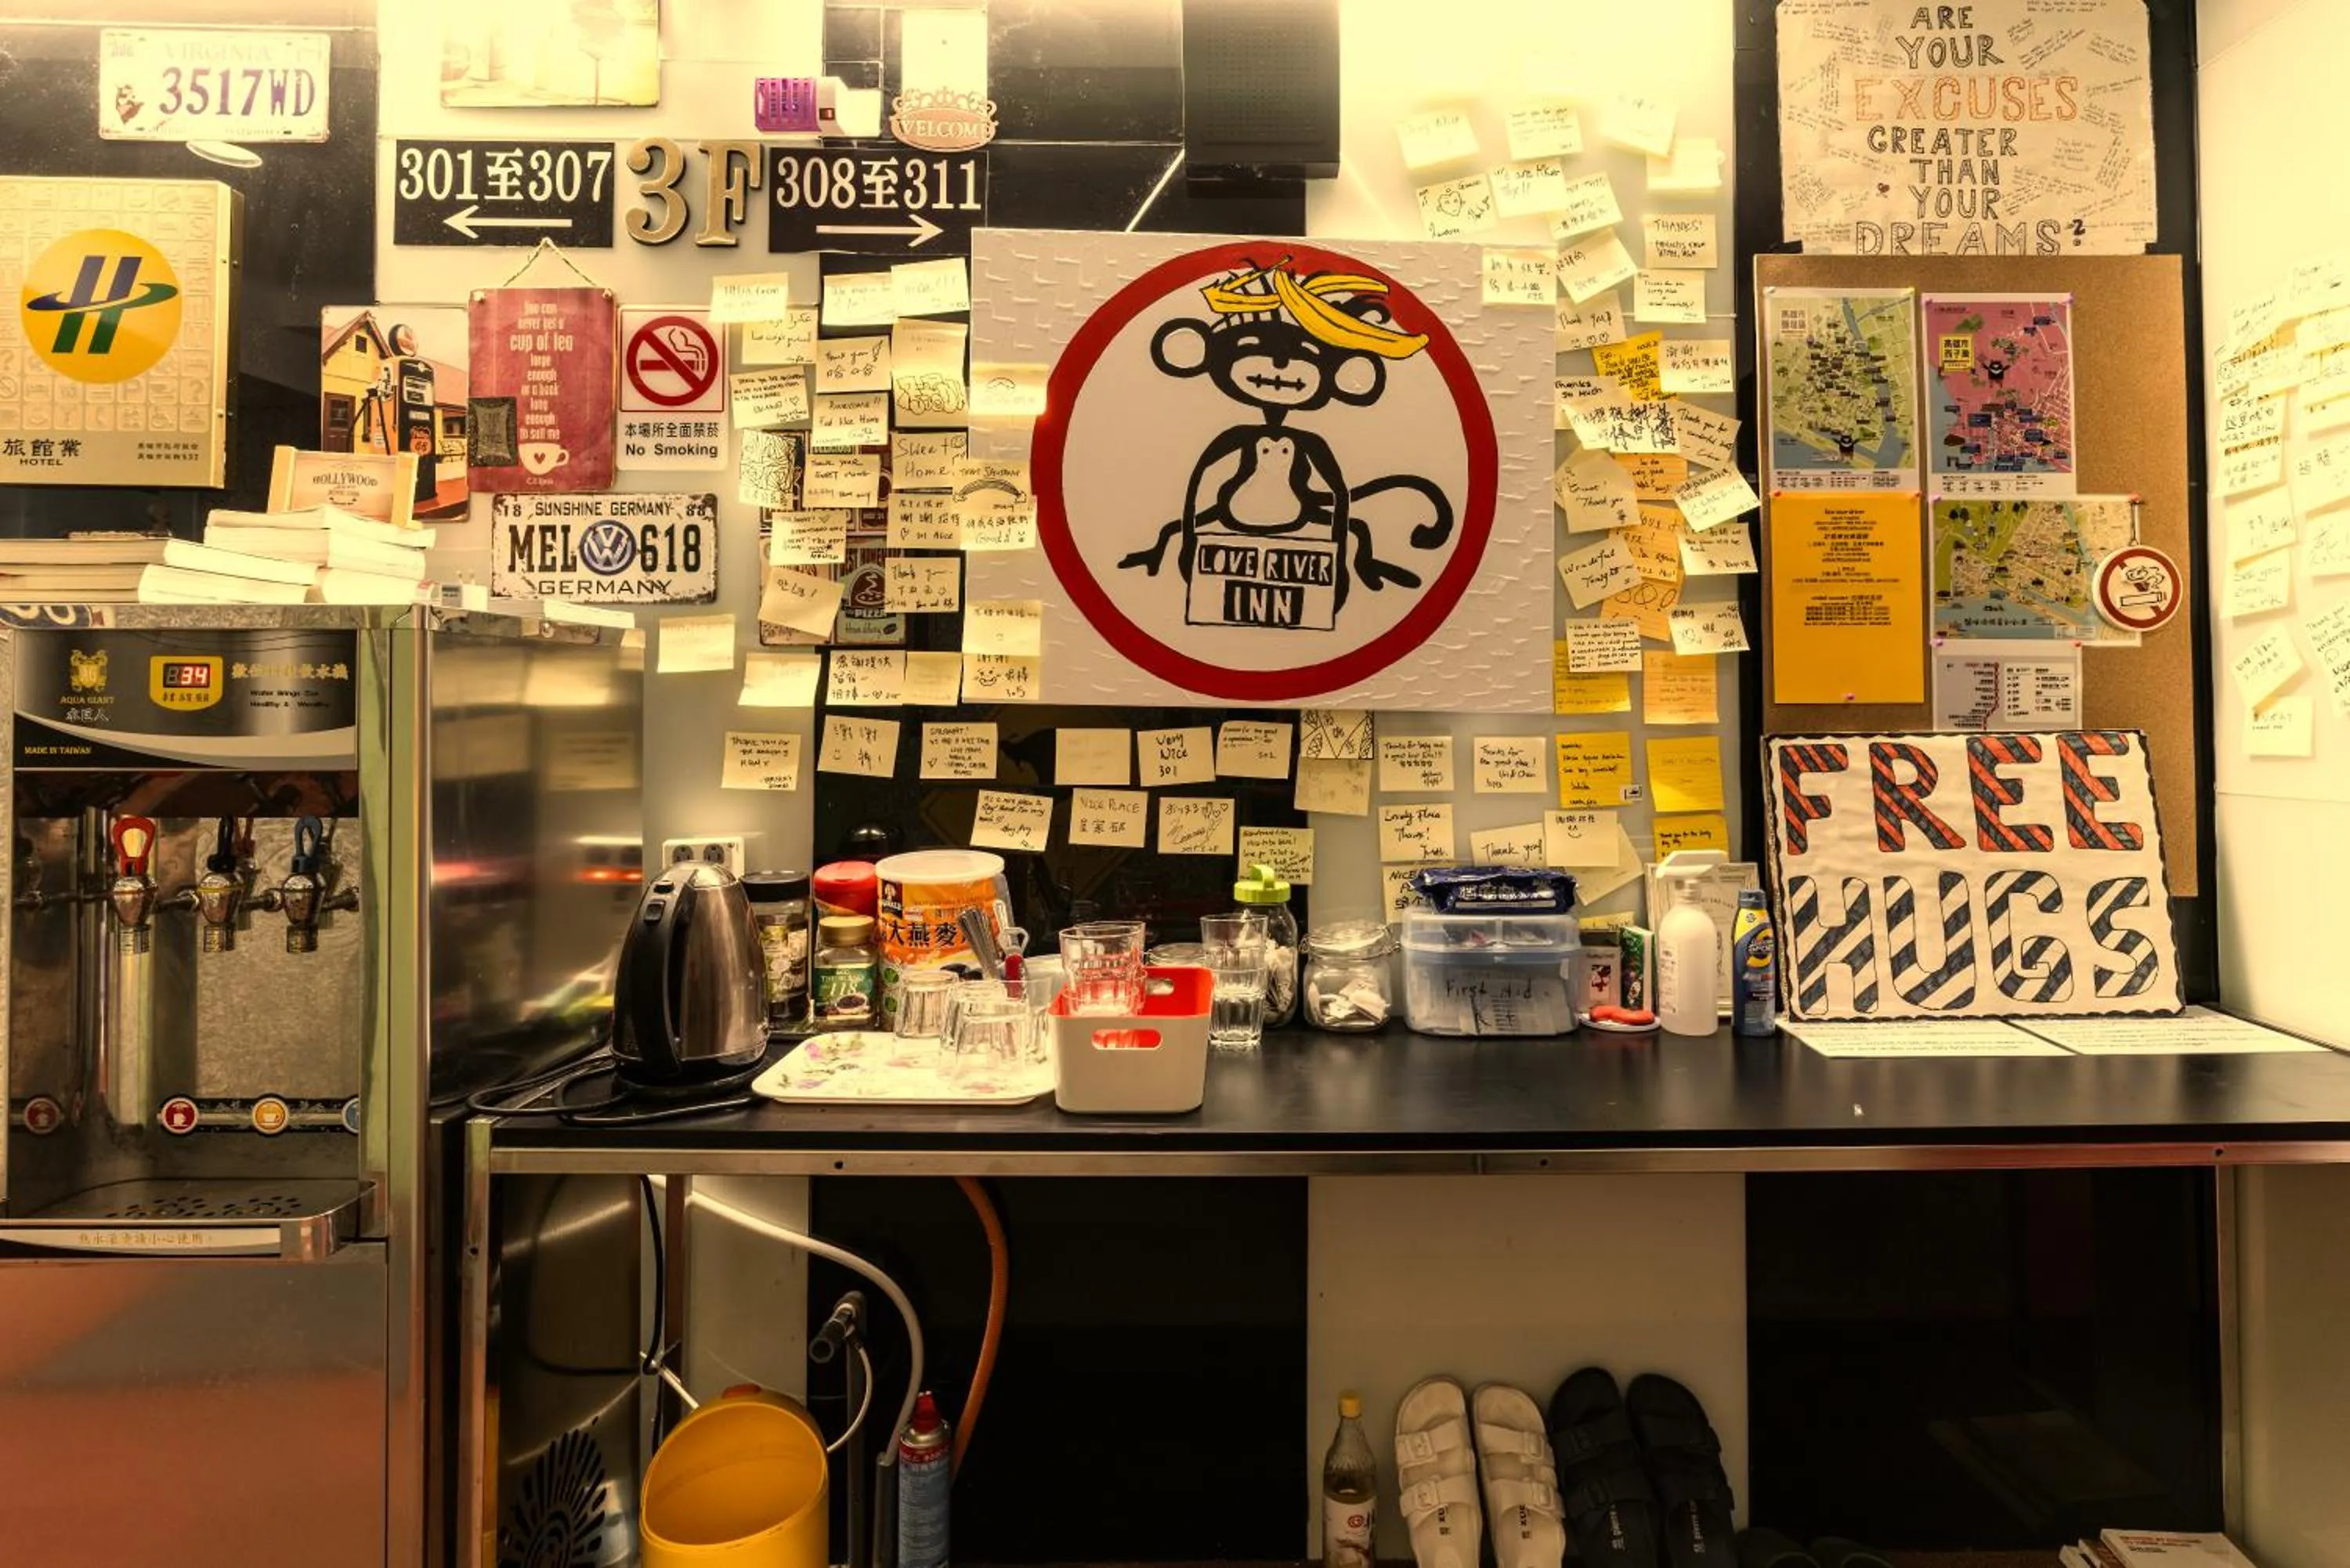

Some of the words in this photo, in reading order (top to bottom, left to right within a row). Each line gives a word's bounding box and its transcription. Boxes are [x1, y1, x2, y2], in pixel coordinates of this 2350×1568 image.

[1909, 5, 1974, 30] ARE
[1895, 34, 2005, 70] YOUR
[159, 67, 316, 117] 3517WD
[1854, 76, 2079, 122] EXCUSES
[900, 120, 993, 139] WELCOME
[1867, 125, 2019, 157] GREATER
[399, 146, 612, 201] 301至307
[776, 156, 982, 210] 308至311
[1909, 158, 2001, 186] THAN
[625, 136, 763, 247] 3F
[1907, 186, 2001, 220] YOUR
[510, 335, 533, 352] cup
[536, 332, 548, 351] of
[553, 334, 573, 352] tea
[624, 422, 719, 439] 本場所全面禁菸
[2, 439, 82, 457] 旅館業
[626, 444, 645, 456] No
[654, 443, 718, 458] Smoking
[503, 505, 522, 518] 18
[536, 501, 603, 517] SUNSHINE
[609, 501, 672, 516] GERMANY
[686, 504, 706, 517] 88
[508, 524, 577, 573] MEL
[640, 524, 702, 572] 618
[1200, 548, 1256, 576] LOVE
[1267, 551, 1332, 583] RIVER
[537, 579, 673, 595] GERMANY
[1234, 587, 1292, 623] INN
[179, 666, 209, 685] 34
[87, 695, 114, 704] GIANT
[24, 746, 48, 754] MADE
[49, 746, 57, 754] IN
[60, 746, 92, 754] TAIWAN
[1108, 797, 1141, 814] PLACE
[1778, 732, 2145, 855] FREE
[1482, 843, 1518, 860] Thank
[889, 919, 966, 948] 大燕麥
[1788, 868, 2160, 1016] HUGS
[830, 982, 858, 996] 118
[1446, 979, 1488, 997] First
